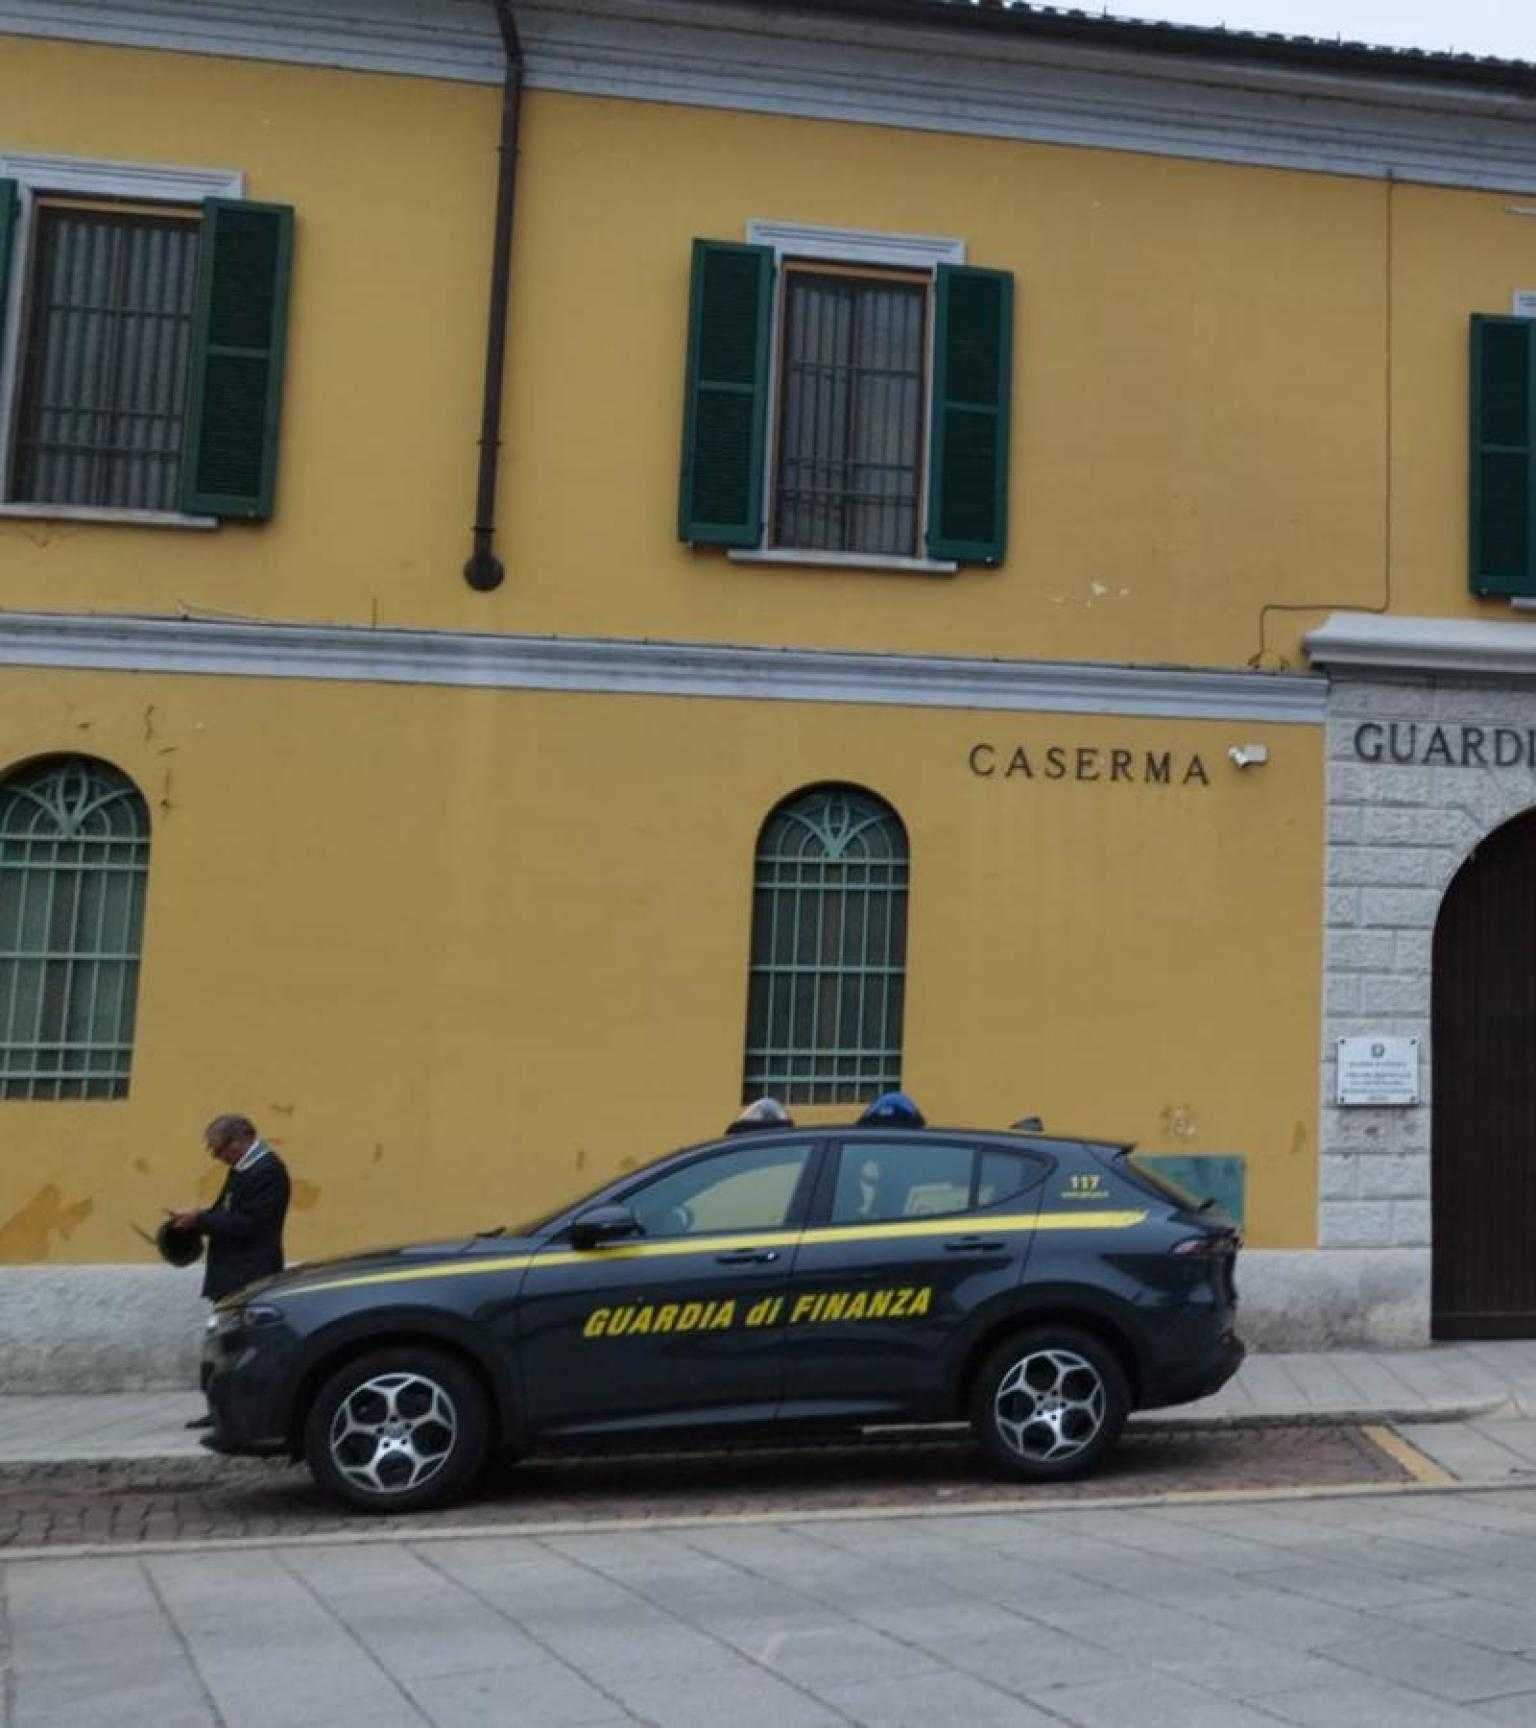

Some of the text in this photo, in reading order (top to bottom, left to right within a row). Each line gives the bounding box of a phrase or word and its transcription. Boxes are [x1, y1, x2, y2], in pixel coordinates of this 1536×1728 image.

[968, 742, 1209, 786] CASERMA
[583, 1287, 932, 1337] GUARDIA di FINANZA
